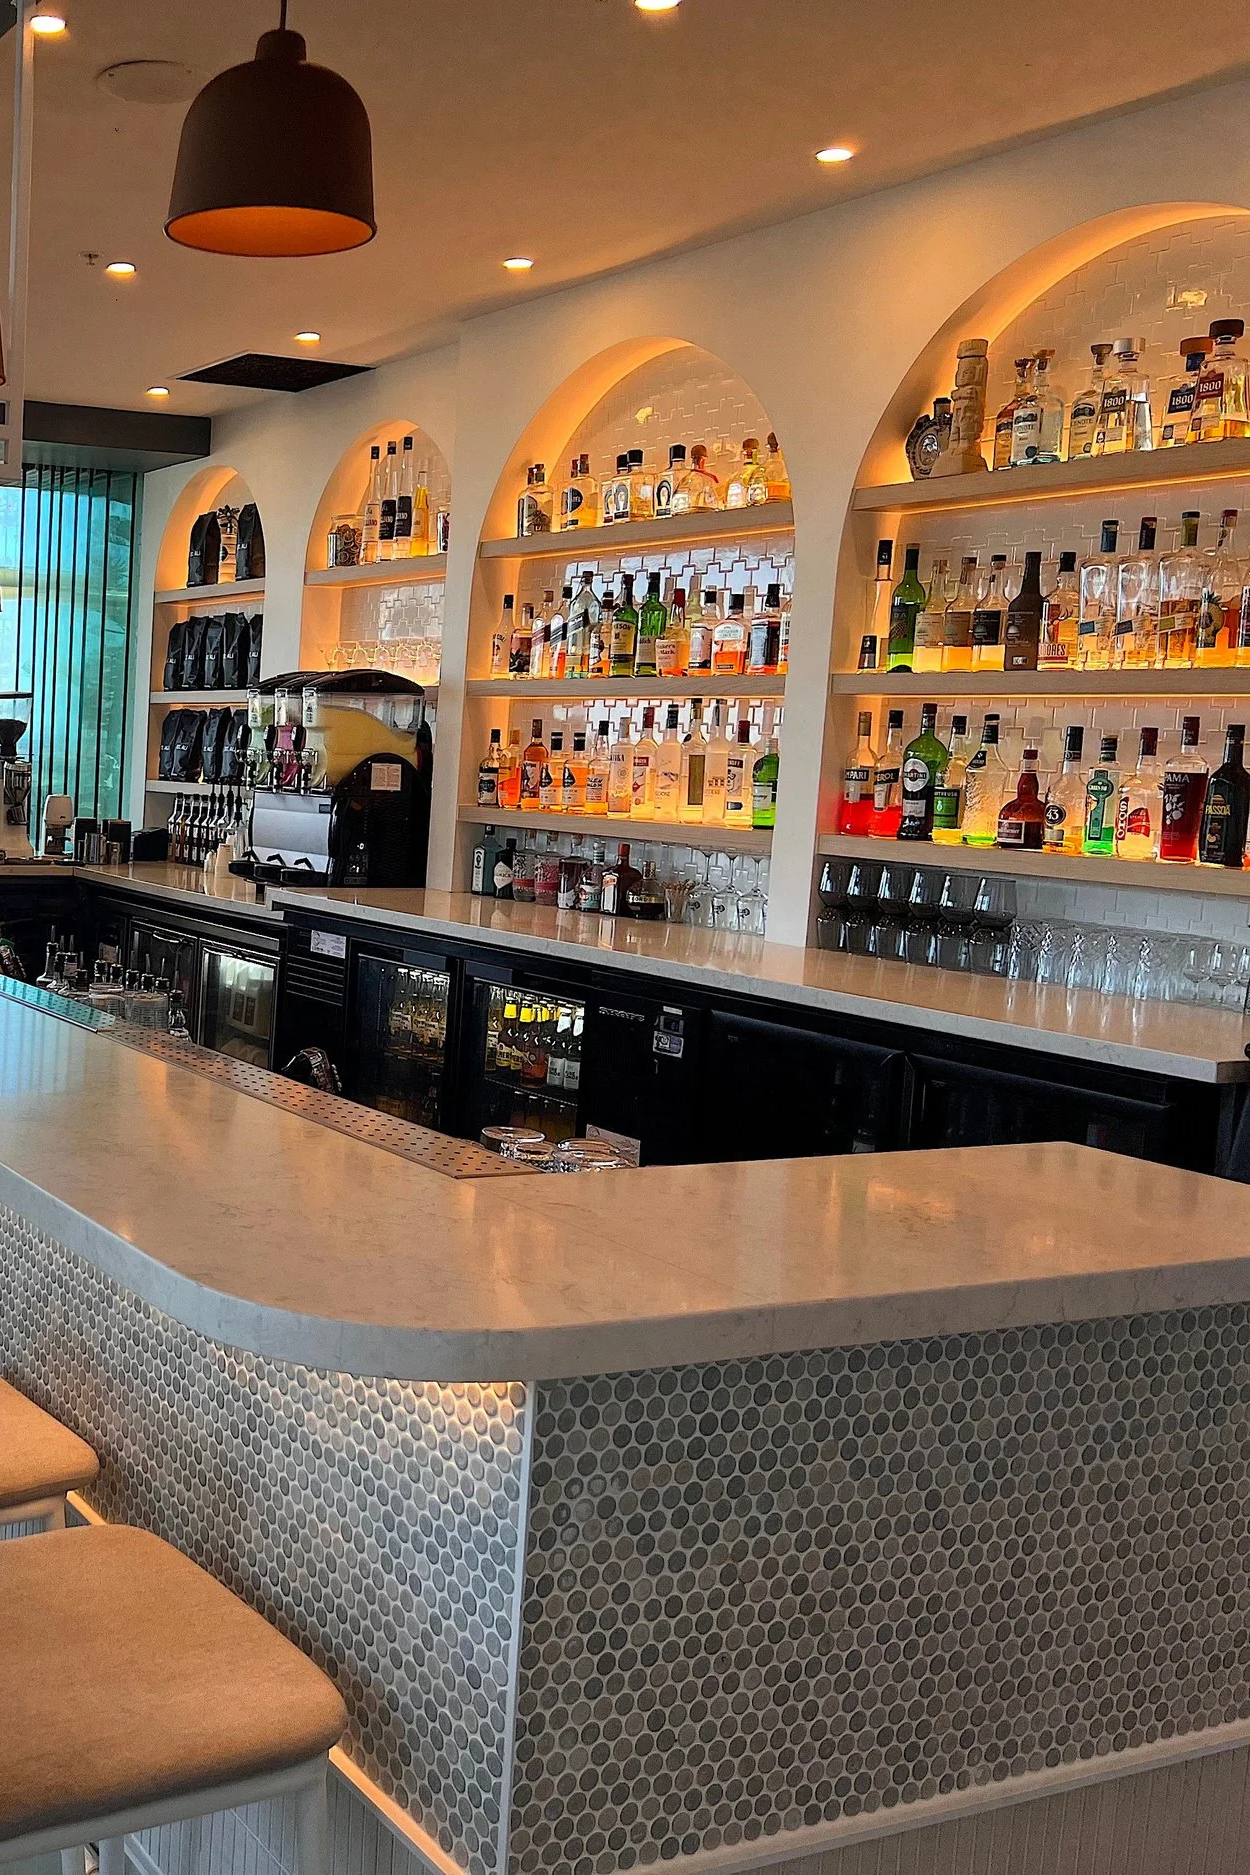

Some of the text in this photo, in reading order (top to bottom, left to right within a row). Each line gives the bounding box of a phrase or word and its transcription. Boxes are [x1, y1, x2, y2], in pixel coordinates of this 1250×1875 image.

[1199, 380, 1222, 393] 1800
[1103, 396, 1125, 408] 1800
[1171, 393, 1194, 406] 1800
[1045, 808, 1060, 820] 43
[1116, 801, 1128, 839] SOHO
